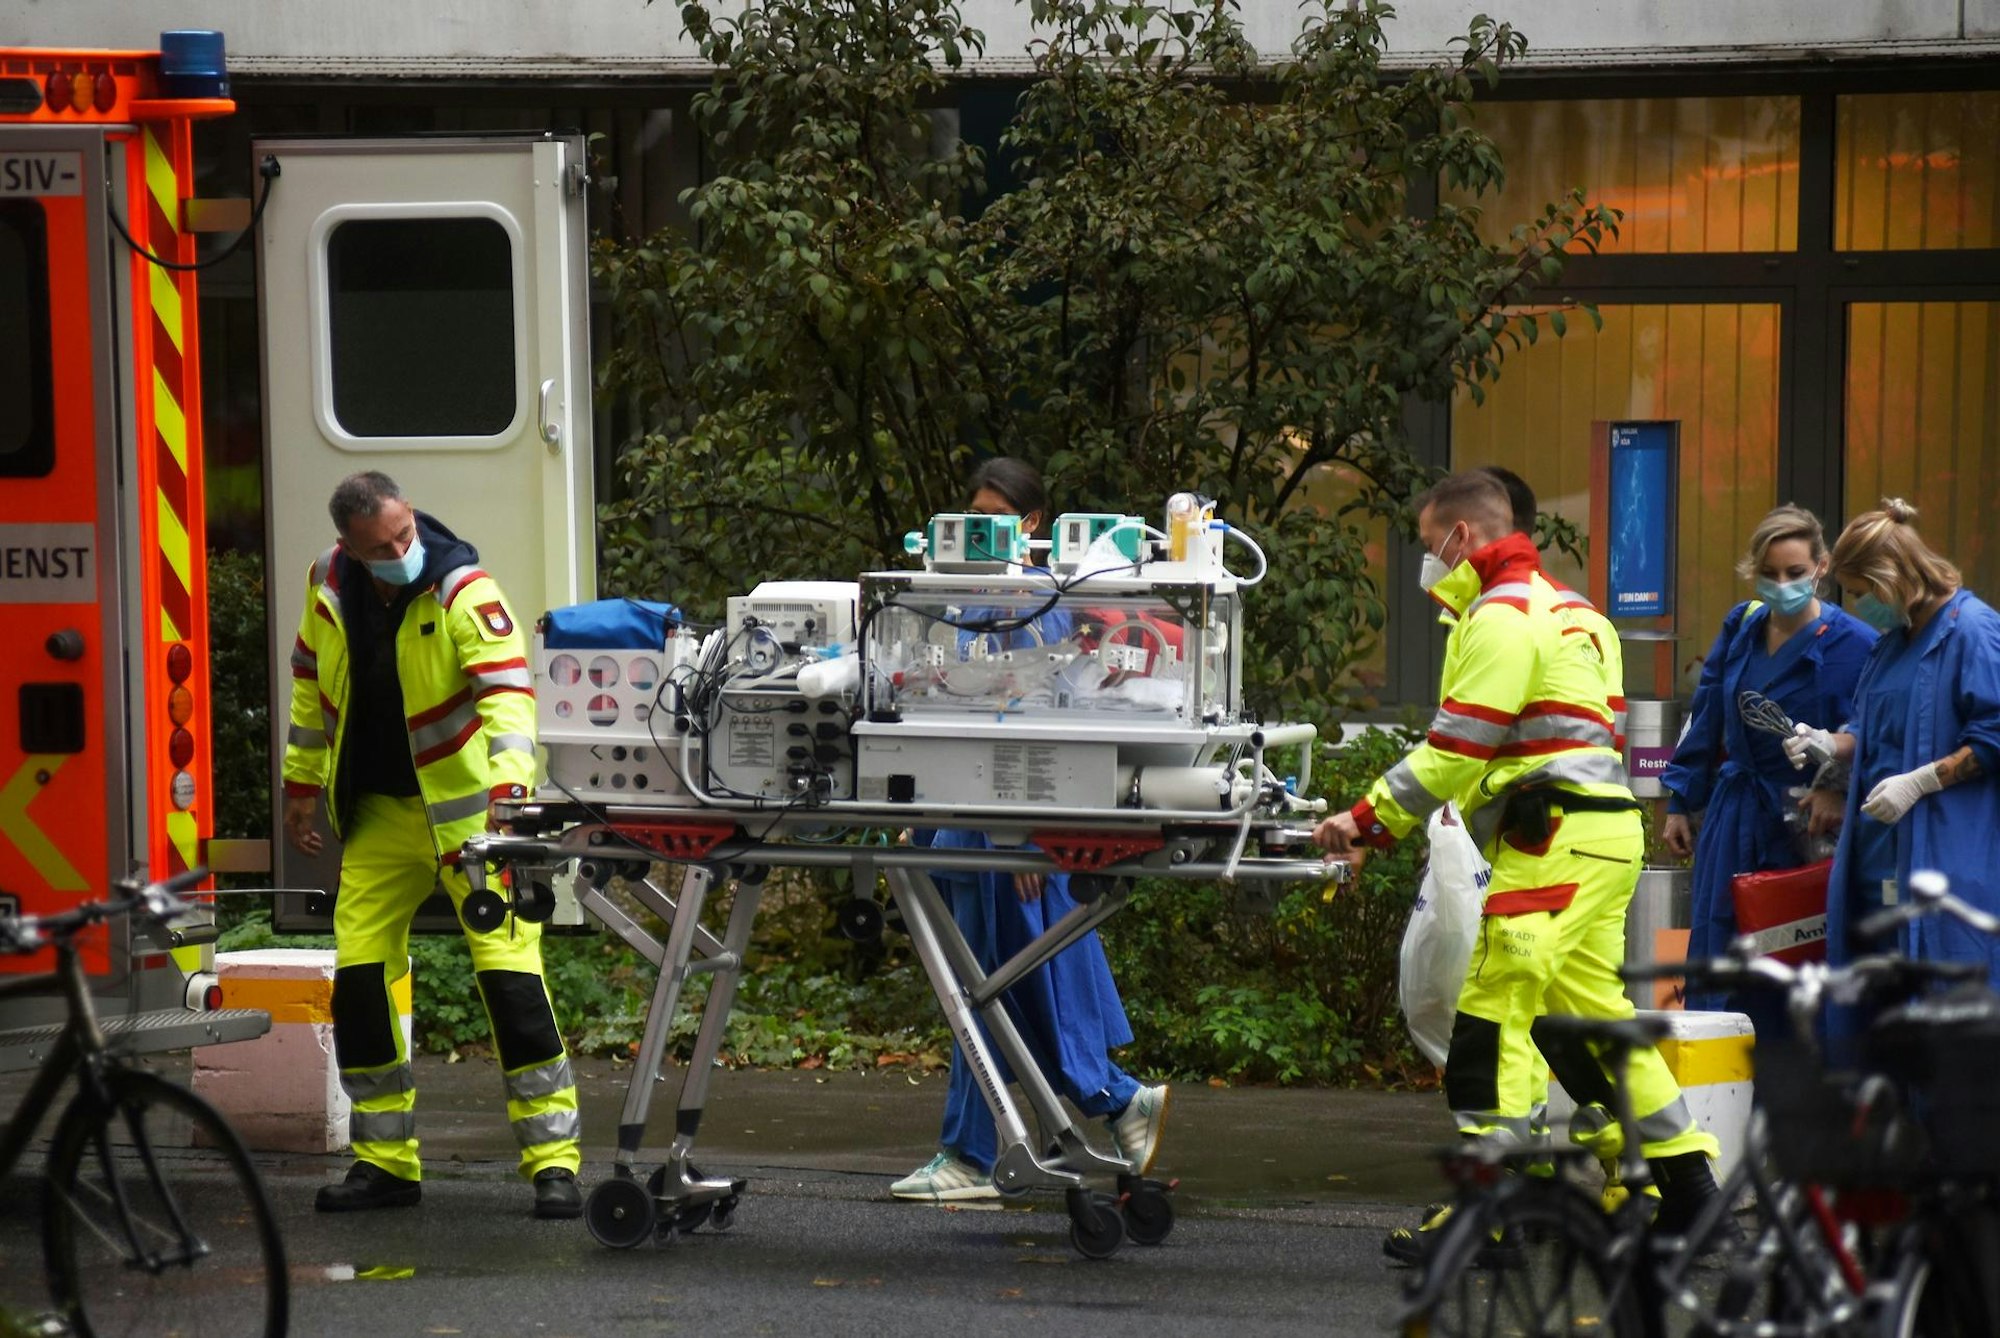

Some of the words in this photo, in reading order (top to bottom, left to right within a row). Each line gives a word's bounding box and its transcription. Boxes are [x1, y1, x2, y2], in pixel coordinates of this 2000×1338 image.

[0, 158, 75, 190] SIV-
[0, 547, 89, 579] ENST
[1502, 928, 1536, 942] STADT
[961, 1028, 1007, 1115] STOLLENWERK
